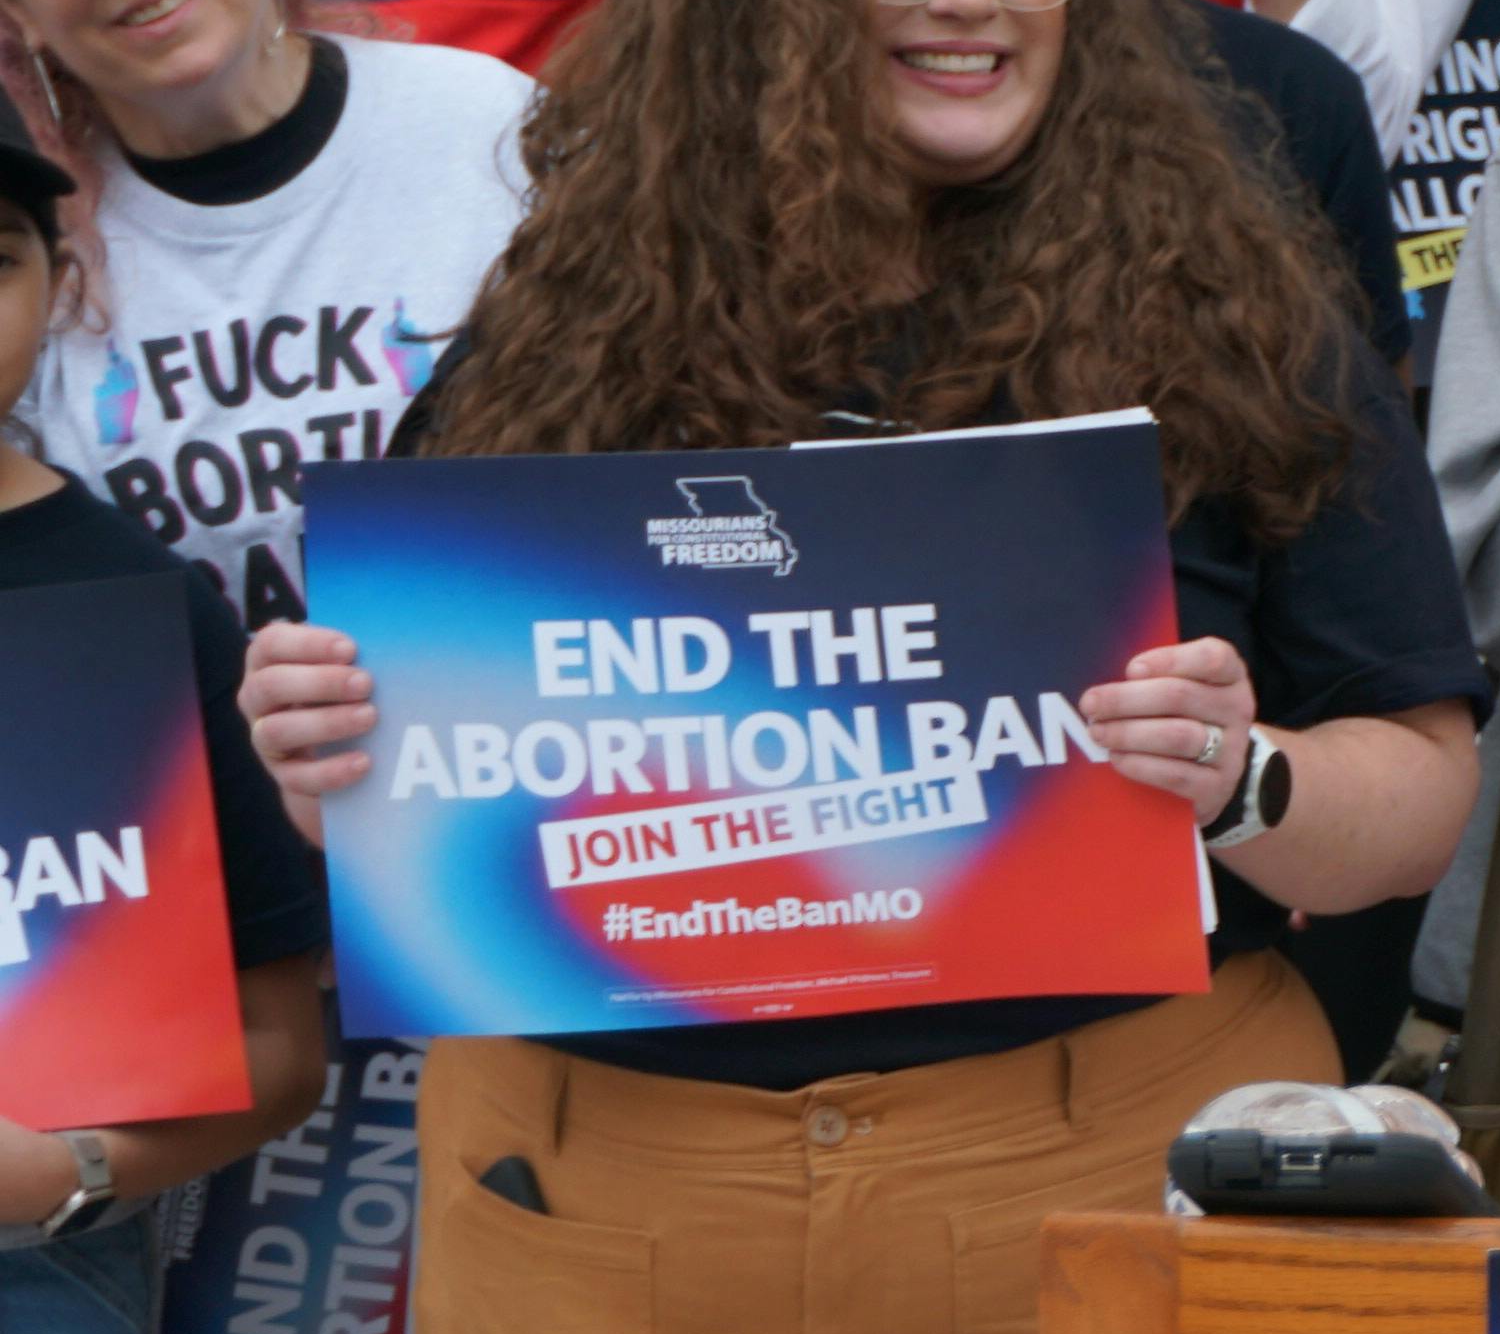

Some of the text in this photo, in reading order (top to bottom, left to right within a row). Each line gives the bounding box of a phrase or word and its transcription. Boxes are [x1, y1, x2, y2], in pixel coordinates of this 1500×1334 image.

[141, 305, 380, 422] FUCK
[647, 515, 768, 535] MISSOURIANS
[660, 539, 784, 566] FREEDOM
[532, 603, 943, 699] END THE
[388, 704, 881, 801] ABORTION
[565, 776, 959, 880] JOIN THE FIGHT
[602, 886, 924, 943] #EndTheBanMO
[249, 1063, 345, 1207] TH
